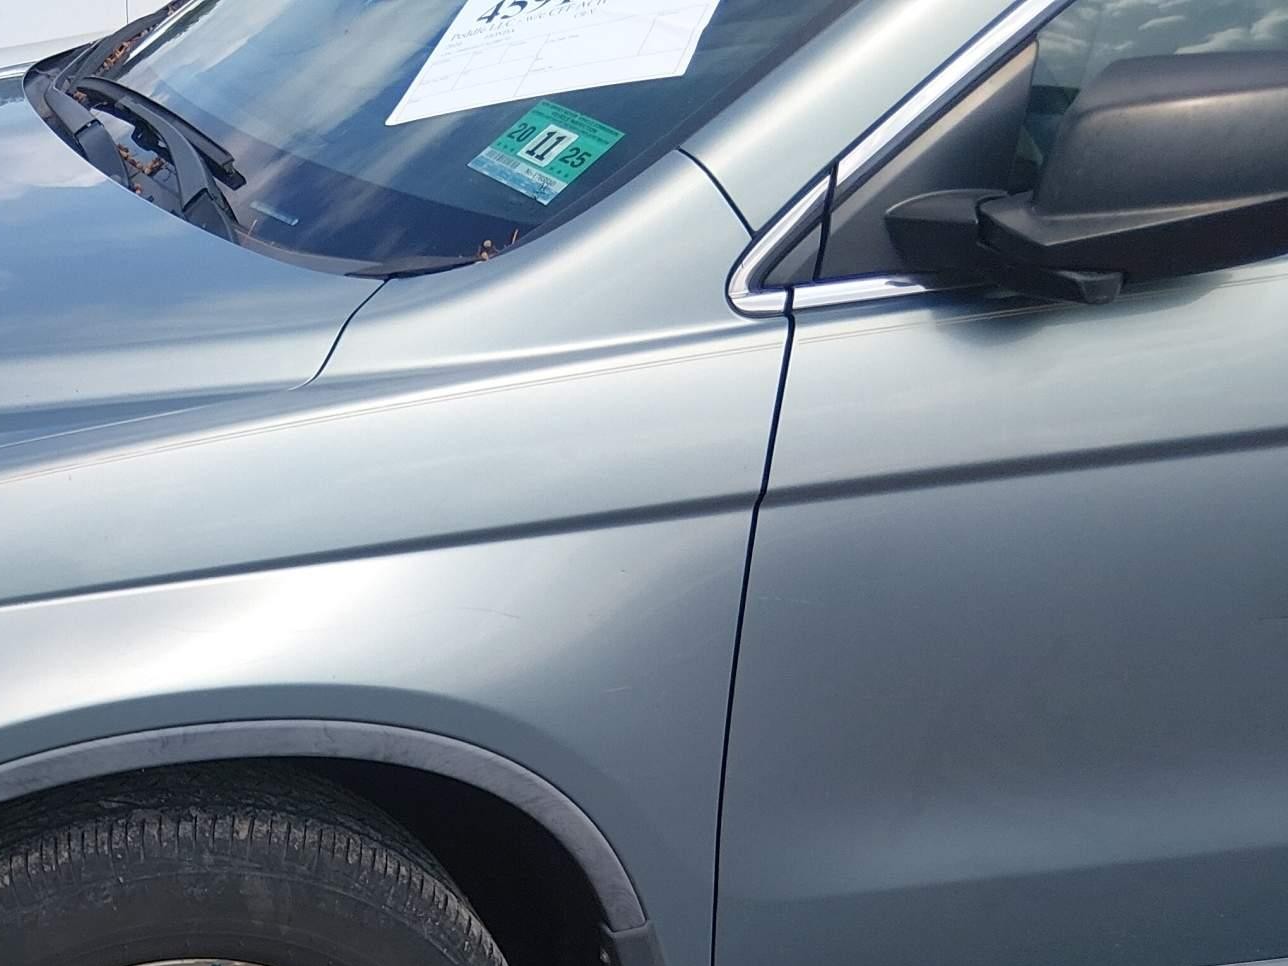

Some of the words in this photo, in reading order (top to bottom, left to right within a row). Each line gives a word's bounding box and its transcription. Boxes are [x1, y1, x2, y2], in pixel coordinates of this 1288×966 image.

[507, 122, 537, 143] 20
[525, 130, 567, 161] 11
[559, 147, 592, 168] 25
